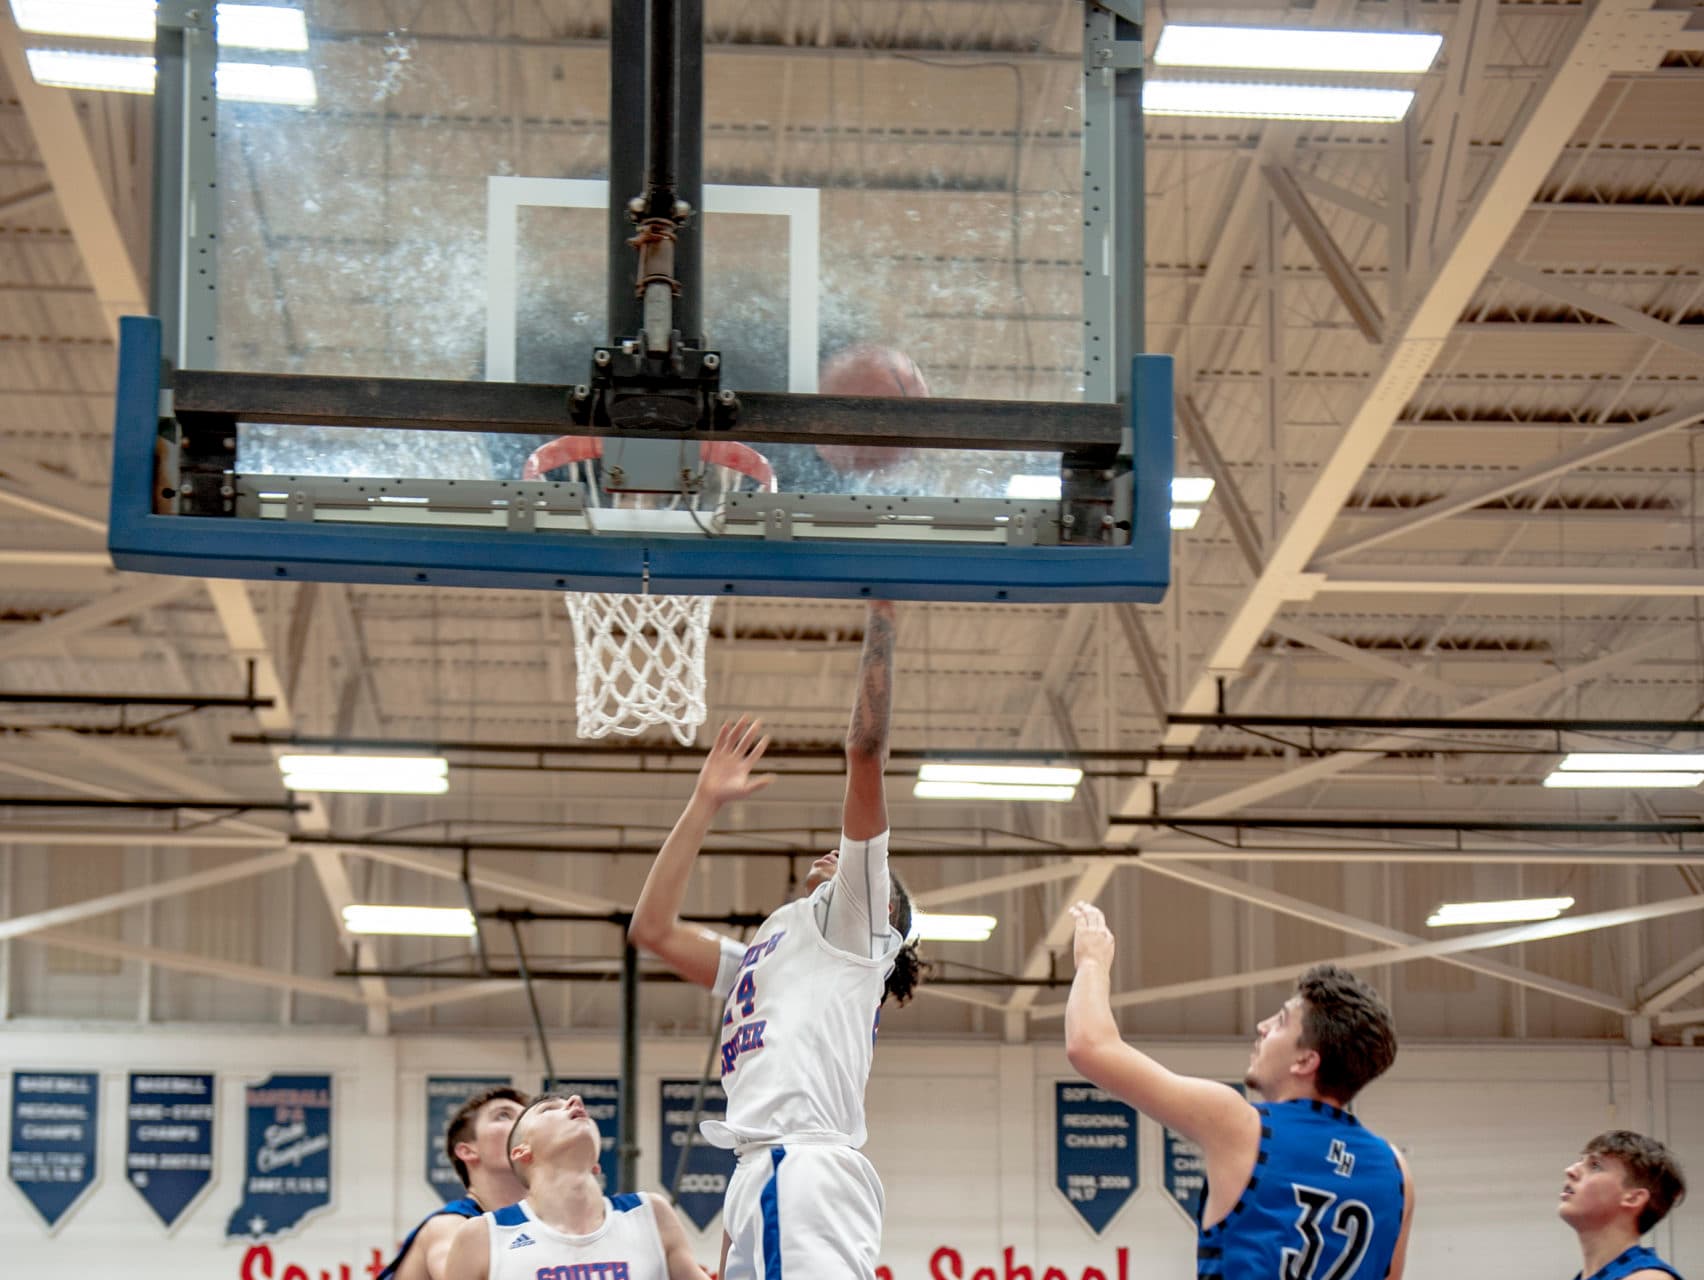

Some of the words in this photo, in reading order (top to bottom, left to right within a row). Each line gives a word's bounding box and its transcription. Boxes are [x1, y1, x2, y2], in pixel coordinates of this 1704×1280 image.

[738, 930, 787, 974] UTH
[1063, 1114, 1129, 1128] REGIONAL
[1065, 1134, 1127, 1148] CHAMPS
